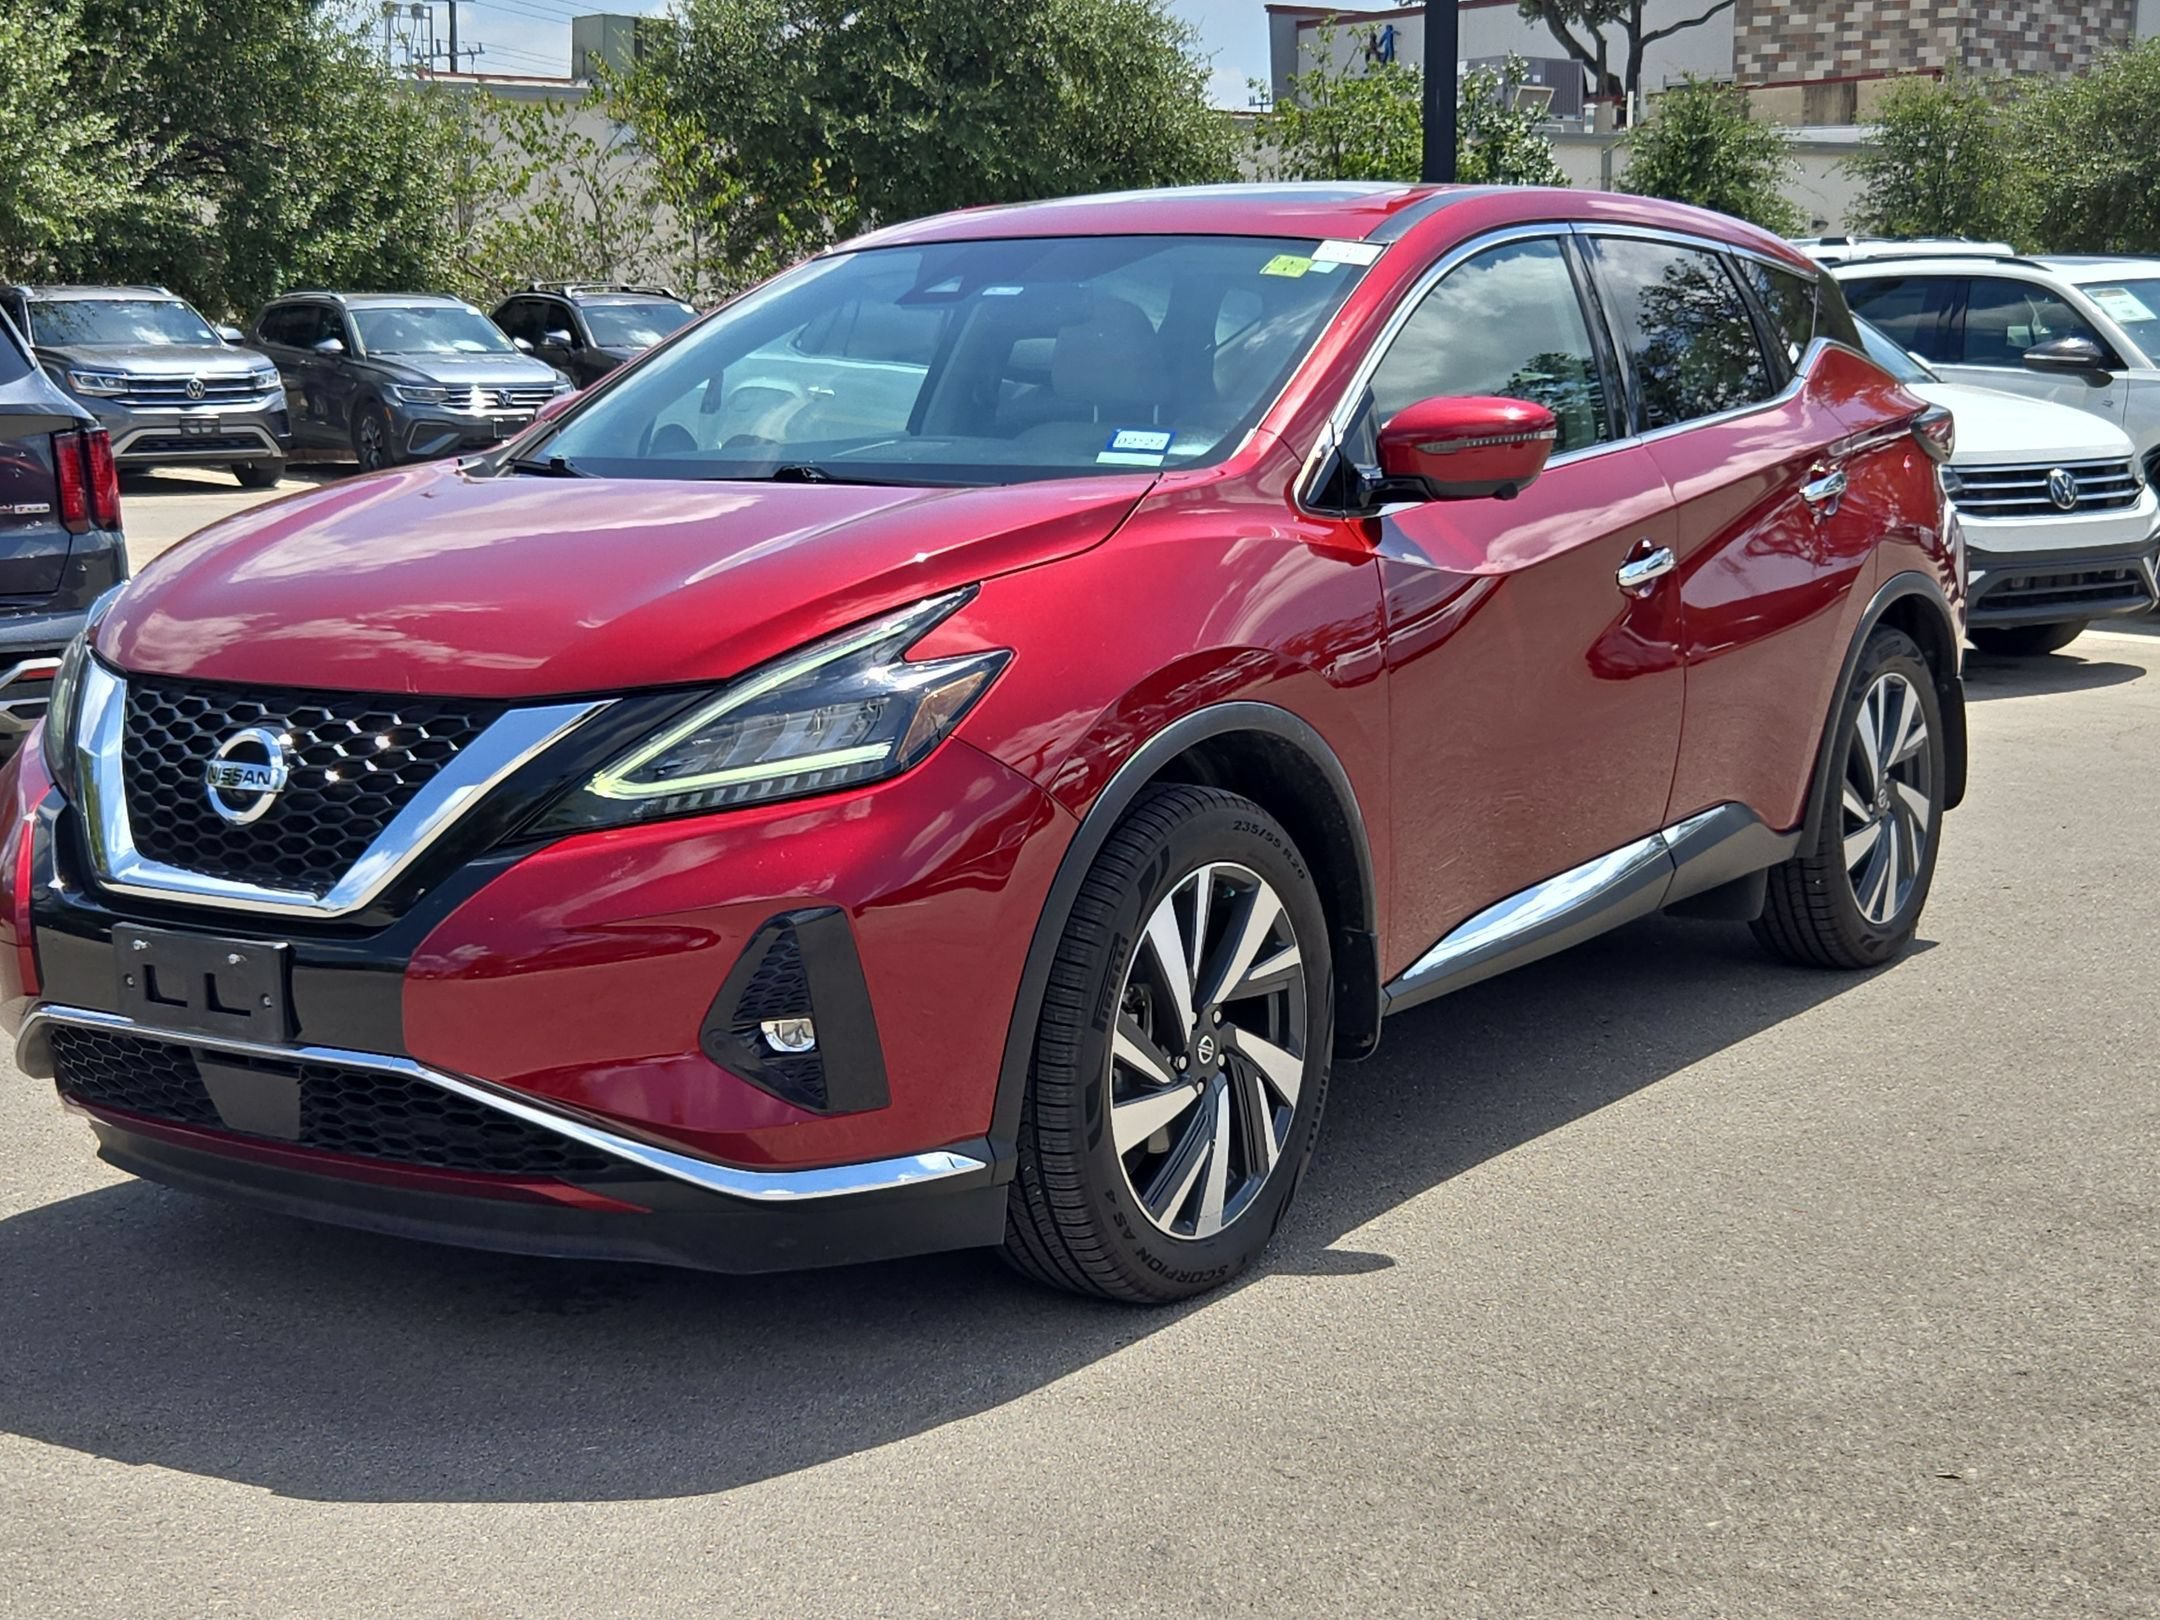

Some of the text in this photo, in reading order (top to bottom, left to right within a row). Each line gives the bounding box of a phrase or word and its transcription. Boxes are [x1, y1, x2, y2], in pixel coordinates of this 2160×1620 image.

[206, 765, 272, 787] NISSAN
[1232, 820, 1281, 848] 235/55
[1104, 1188, 1229, 1284] SCORPION AS 4
